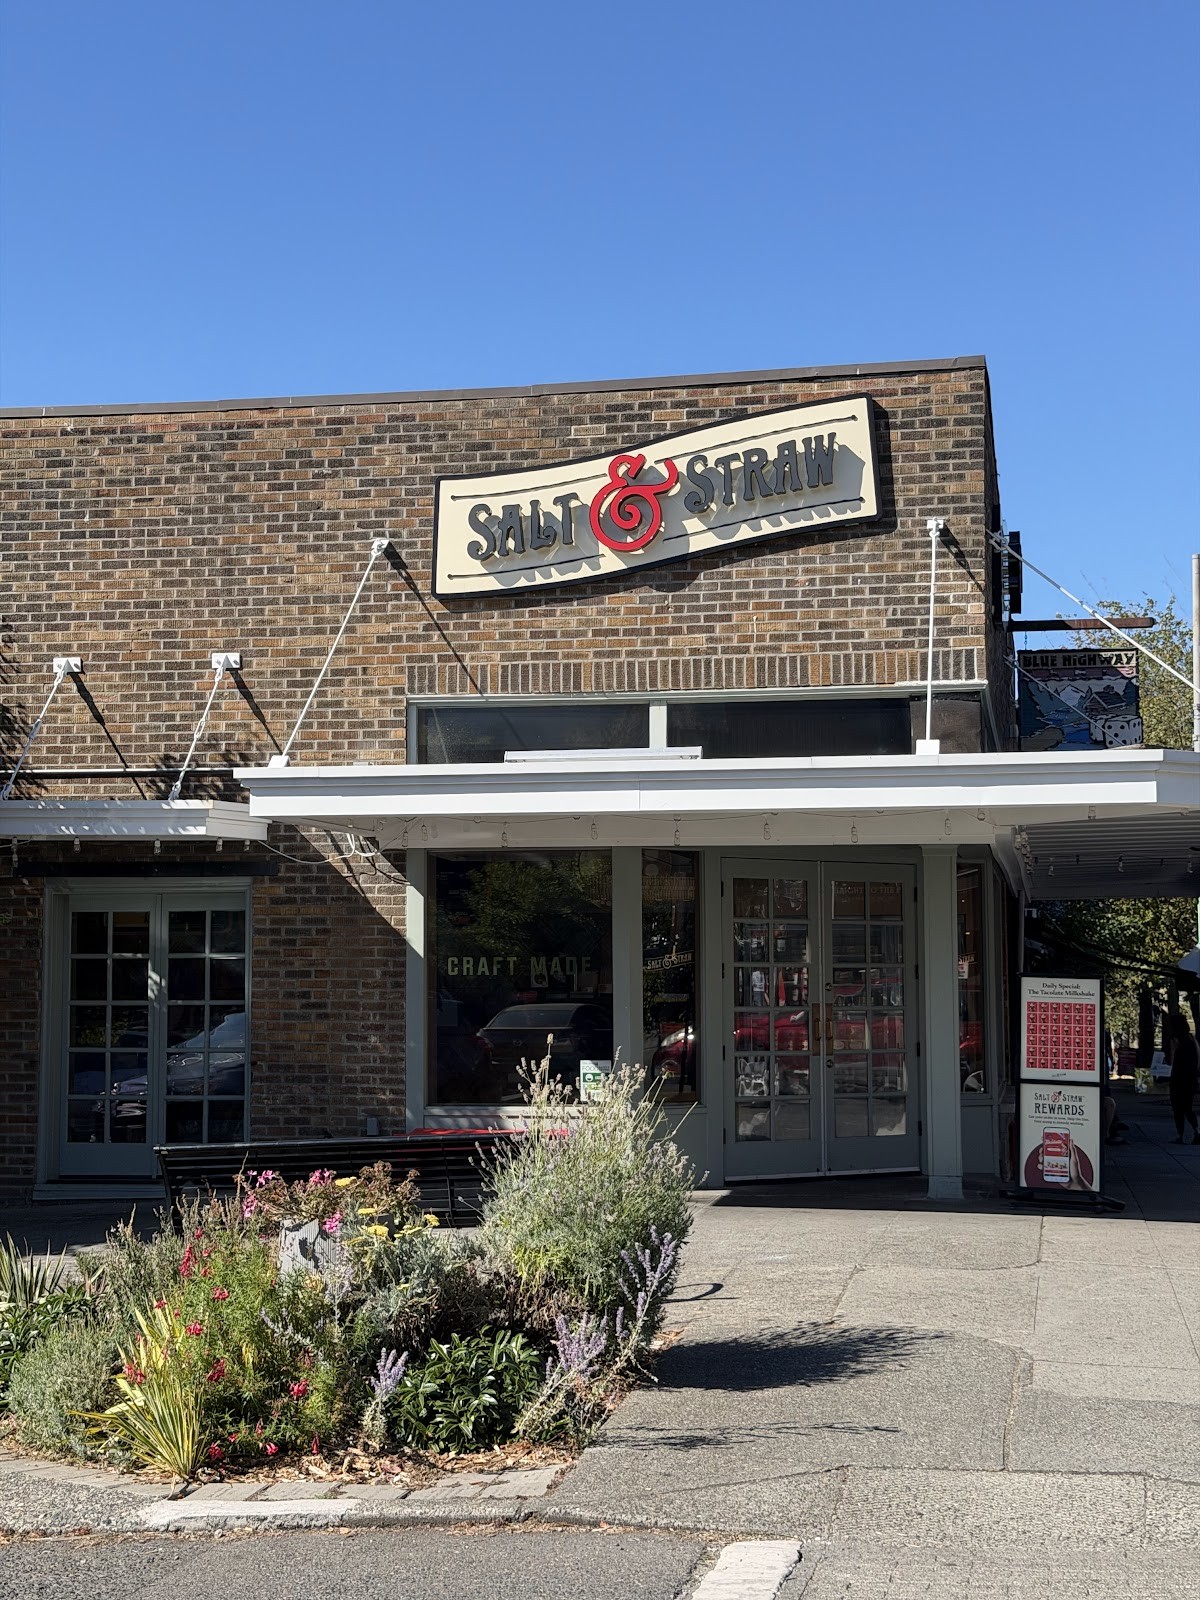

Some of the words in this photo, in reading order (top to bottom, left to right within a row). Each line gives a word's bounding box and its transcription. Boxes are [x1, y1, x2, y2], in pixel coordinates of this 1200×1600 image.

[467, 492, 580, 560] SALT
[590, 453, 679, 552] &
[684, 432, 836, 514] STRAW
[1023, 655, 1057, 668] BLUE
[447, 956, 517, 976] CRAFT
[530, 956, 592, 976] MADE
[647, 959, 662, 970] SALT
[1034, 1092, 1050, 1101] SALT
[1062, 1094, 1083, 1103] STRAW
[1034, 1103, 1085, 1116] REWARDS
